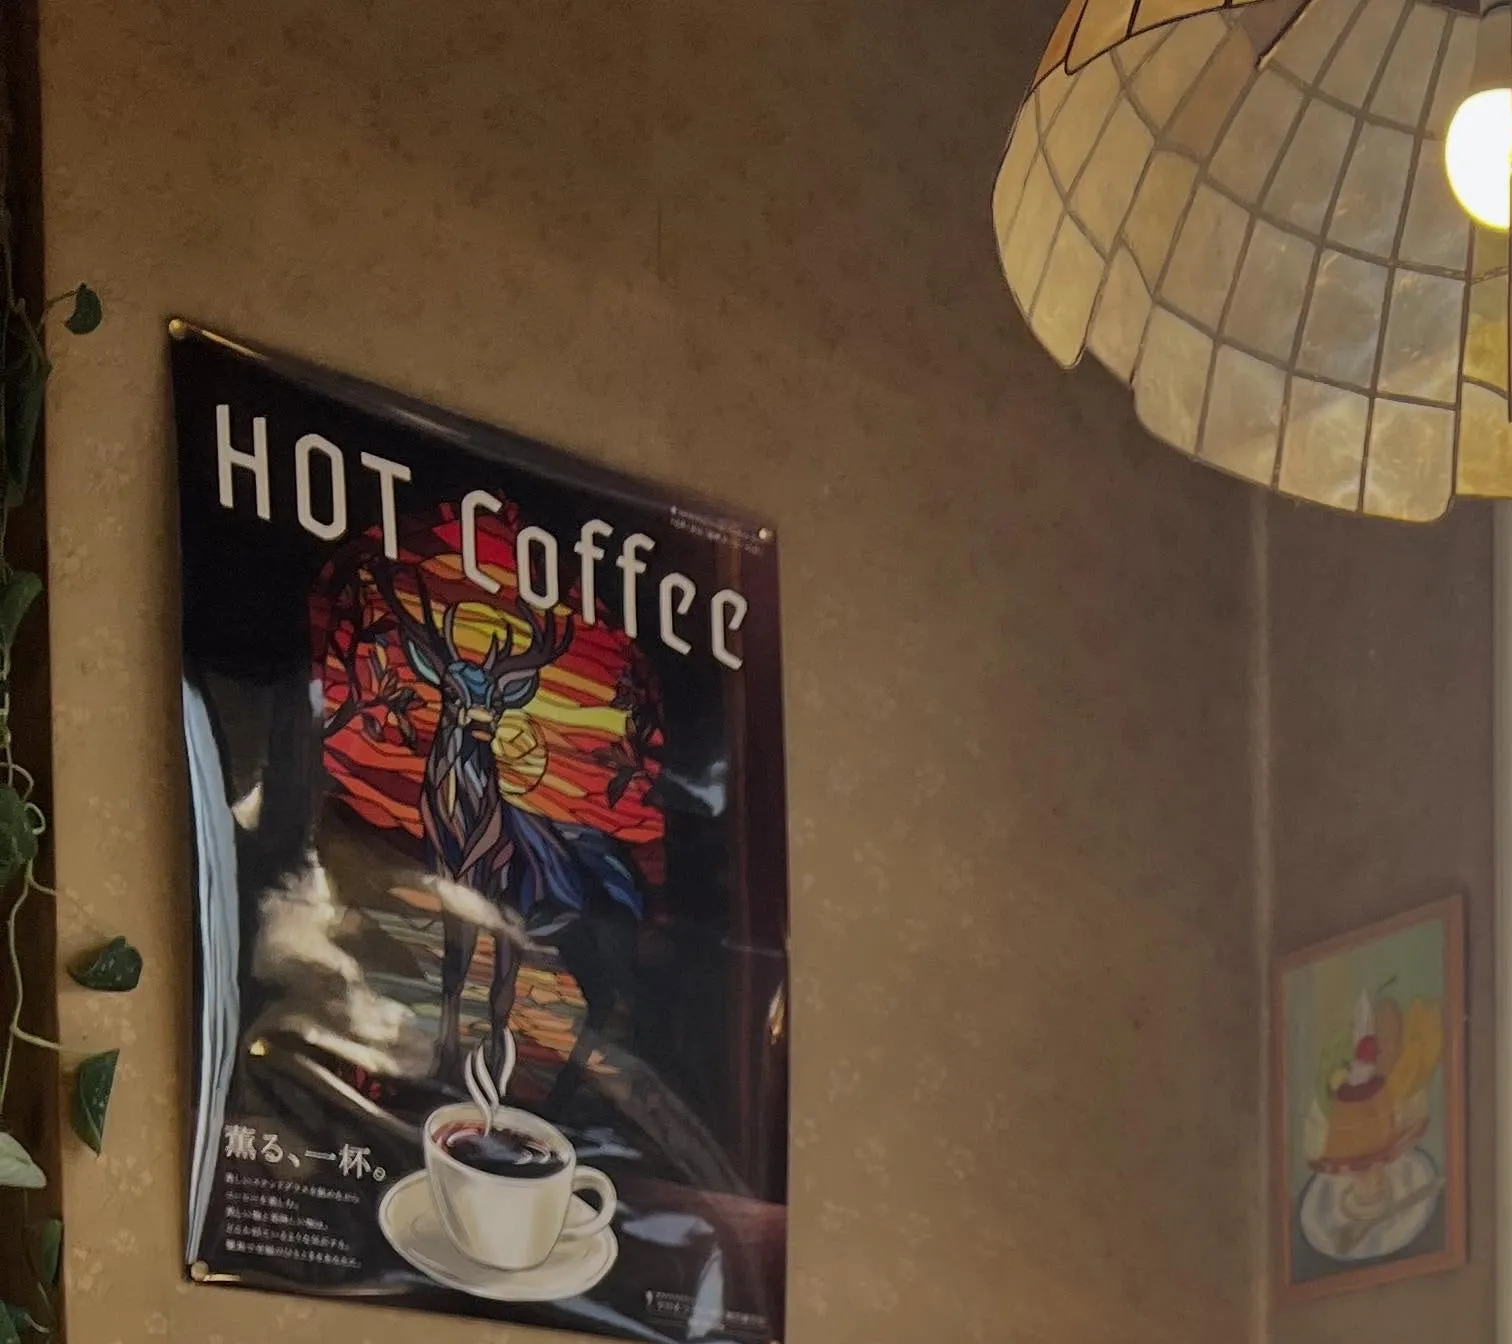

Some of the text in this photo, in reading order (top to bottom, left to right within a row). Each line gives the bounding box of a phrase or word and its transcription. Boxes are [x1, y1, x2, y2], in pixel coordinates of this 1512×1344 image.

[215, 404, 750, 672] HOT Coffee
[224, 1124, 386, 1182] 薫る、一杯。
